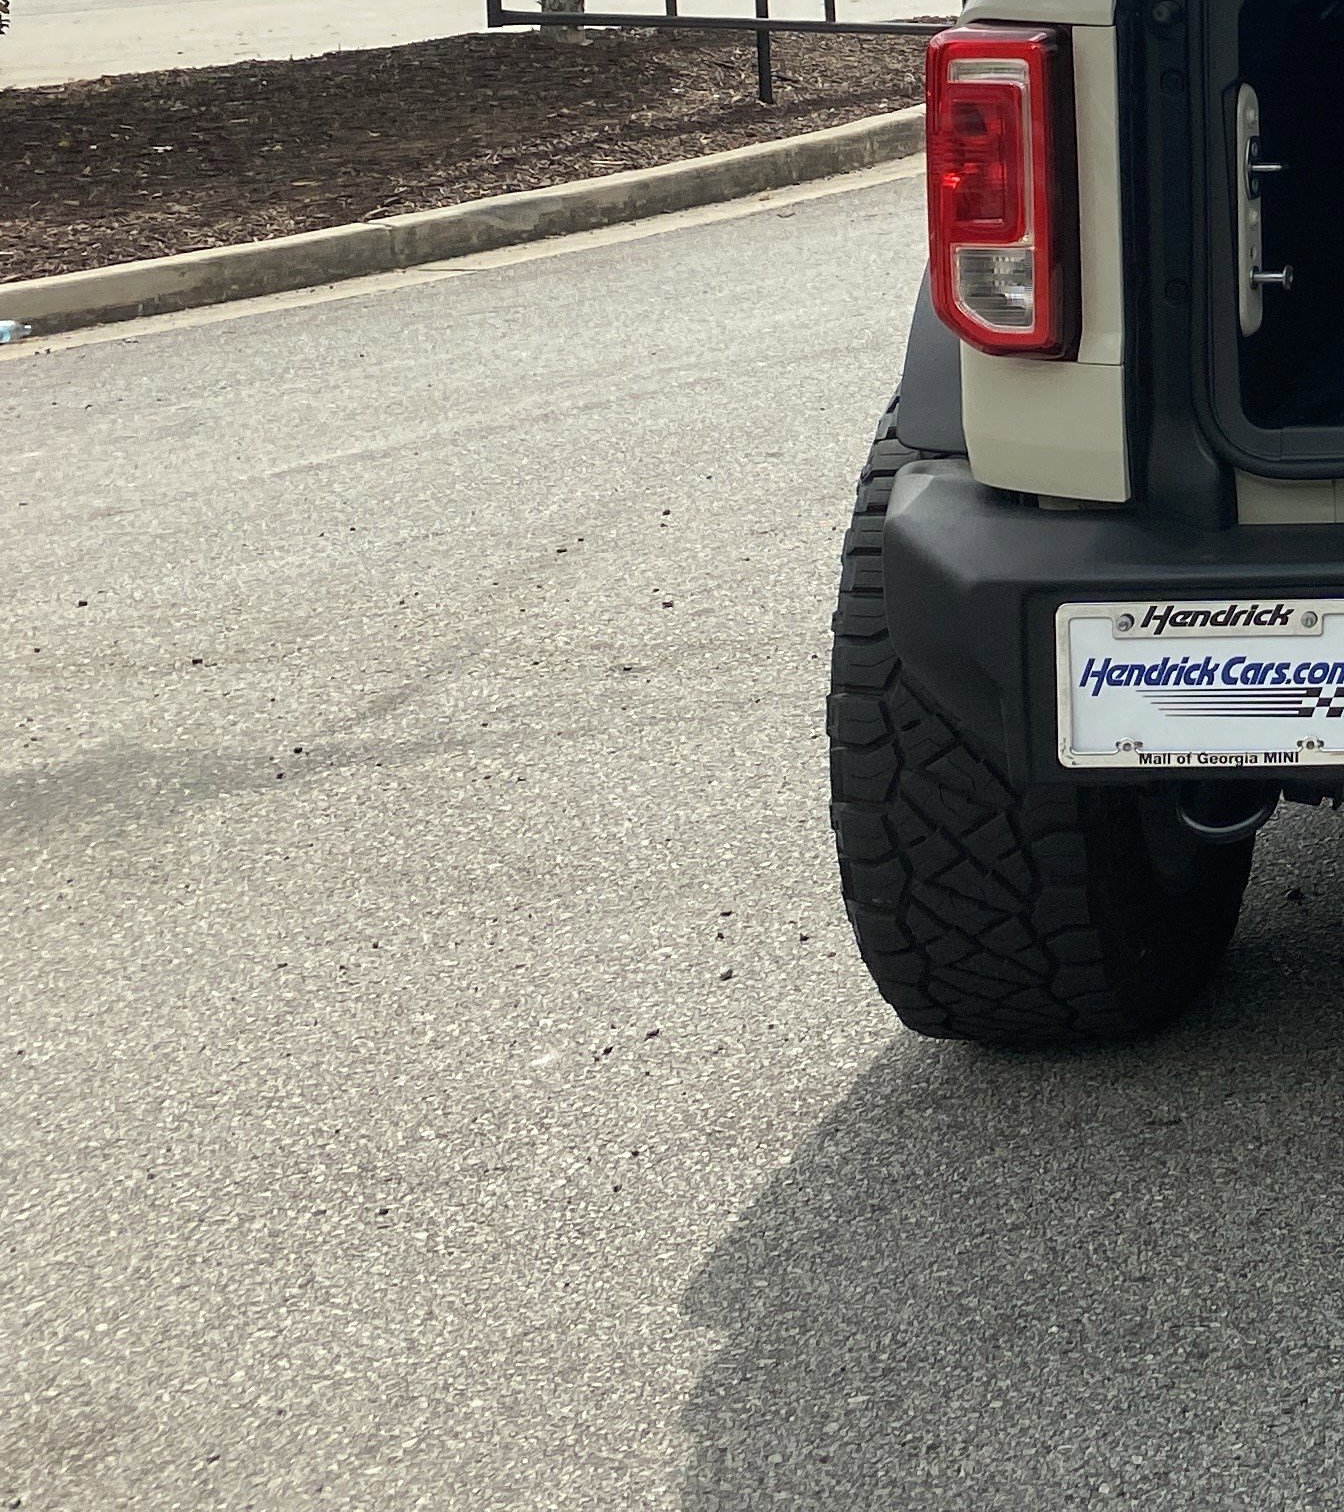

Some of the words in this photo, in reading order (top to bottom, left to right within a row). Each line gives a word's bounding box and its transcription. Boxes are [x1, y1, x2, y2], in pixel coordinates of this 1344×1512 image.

[1140, 604, 1295, 635] Hendrick
[1139, 753, 1171, 765] Mall
[1176, 752, 1192, 764] of
[1197, 752, 1259, 767] Georgia
[1263, 751, 1299, 763] MINI
